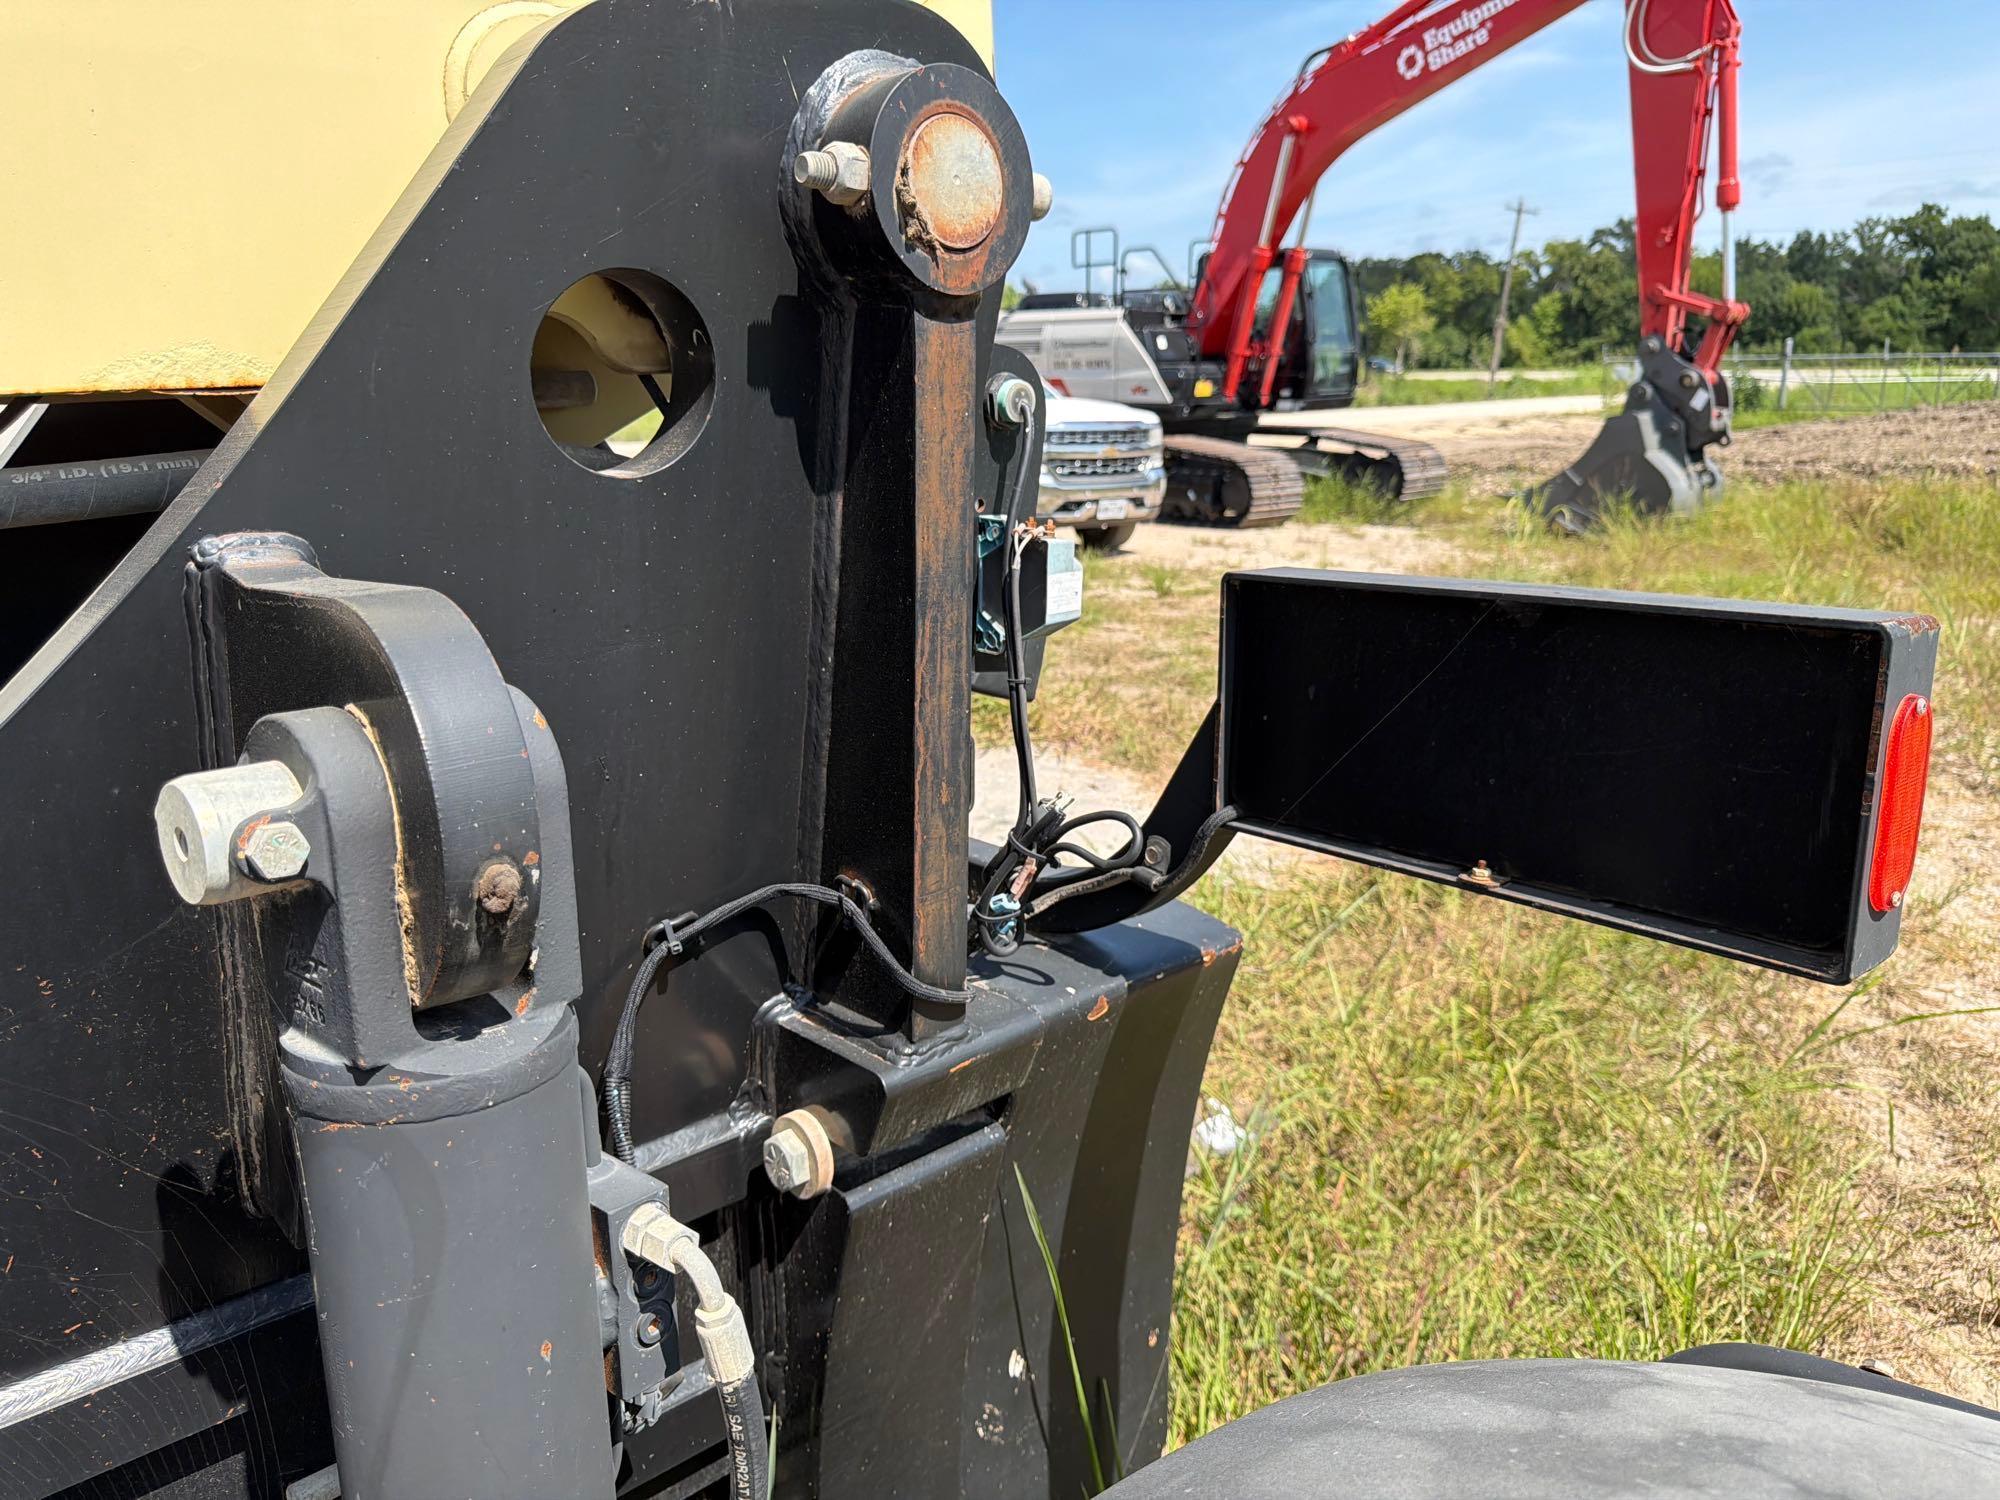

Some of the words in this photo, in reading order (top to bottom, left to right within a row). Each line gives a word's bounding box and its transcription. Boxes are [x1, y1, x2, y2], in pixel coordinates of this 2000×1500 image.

[1427, 27, 1489, 72] Share
[59, 466, 94, 480] I.D.
[100, 462, 150, 478] (19.1
[156, 456, 200, 470] mm)
[728, 1414, 744, 1442] SAE
